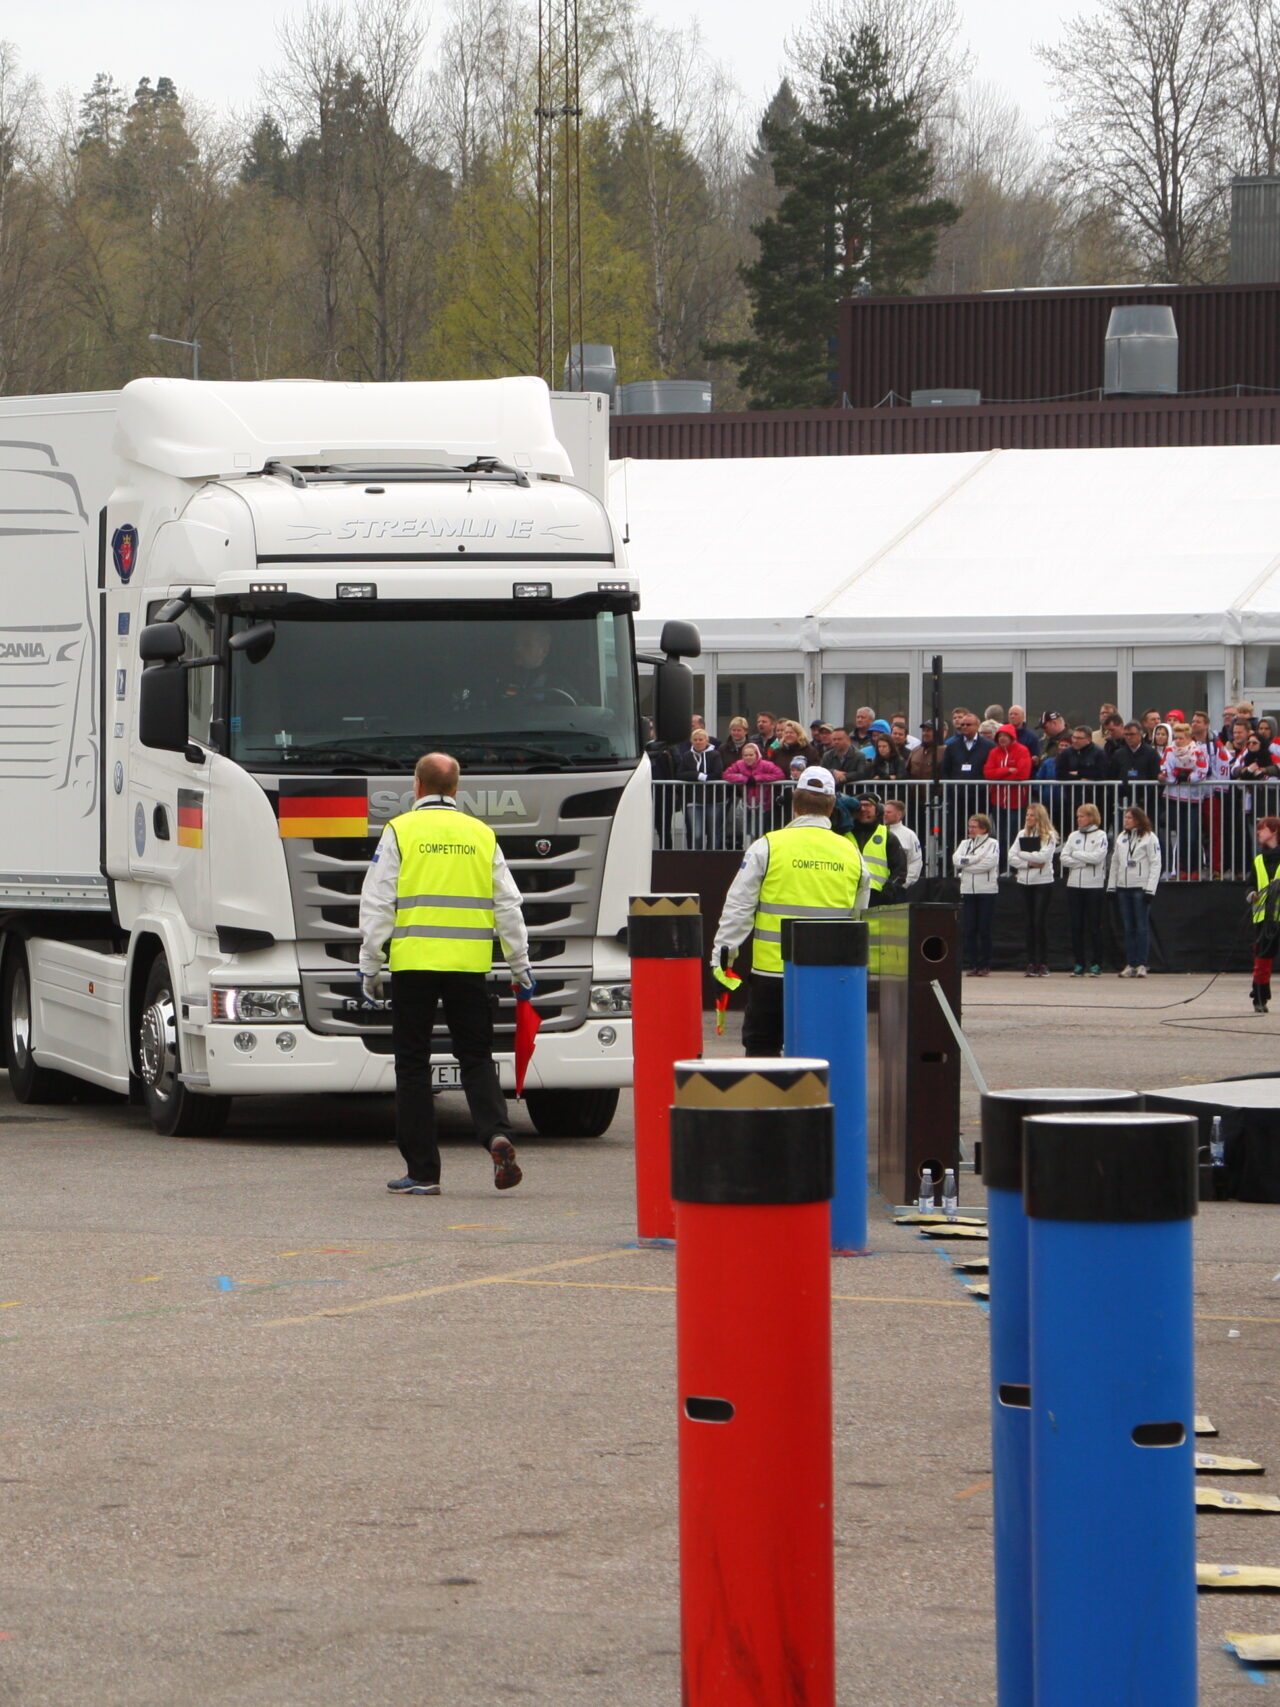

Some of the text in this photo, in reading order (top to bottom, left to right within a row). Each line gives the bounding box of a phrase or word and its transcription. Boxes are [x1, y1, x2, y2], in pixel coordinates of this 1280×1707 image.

[337, 518, 534, 540] STREAMLINE
[369, 790, 528, 818] SNIA
[418, 843, 477, 856] COMPETITION
[792, 858, 845, 872] COMPETITION
